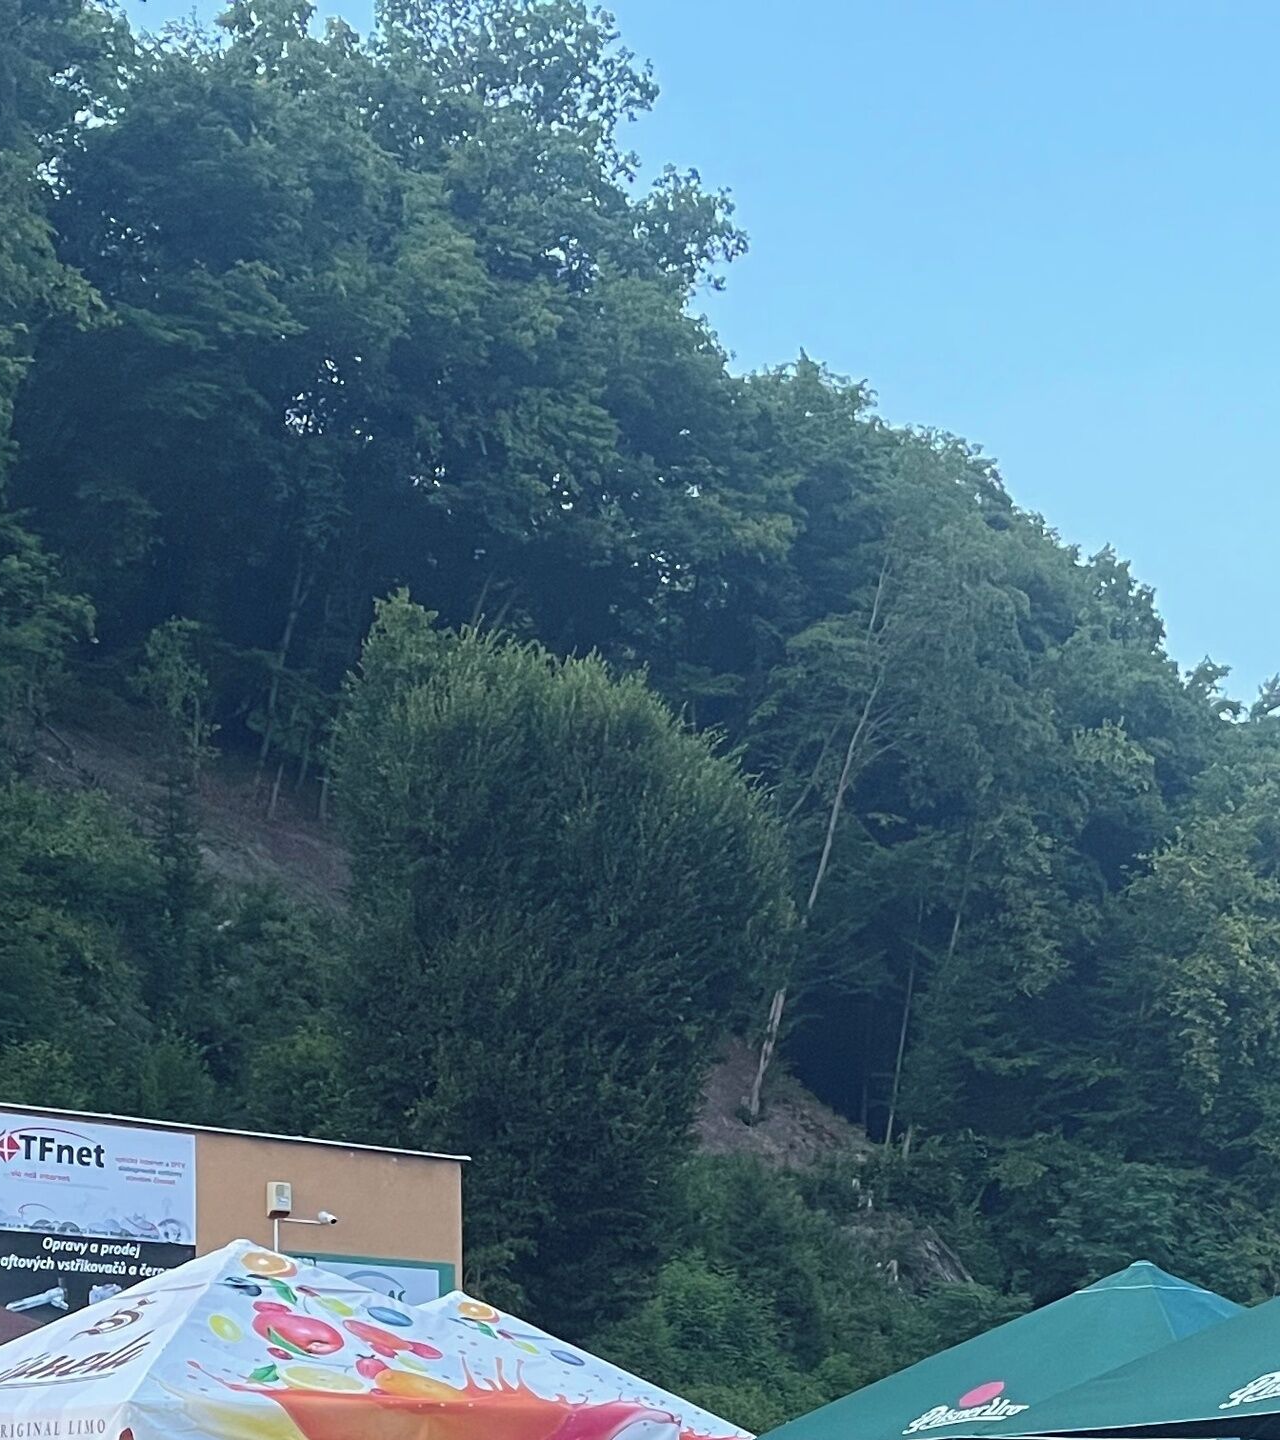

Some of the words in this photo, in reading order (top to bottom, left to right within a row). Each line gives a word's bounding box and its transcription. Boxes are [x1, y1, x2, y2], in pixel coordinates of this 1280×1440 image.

[19, 1134, 105, 1168] TFnet
[42, 1236, 88, 1255] Opravy
[90, 1242, 97, 1253] a
[100, 1243, 141, 1258] prodej
[56, 1258, 126, 1276] vstřikovačů
[128, 1266, 136, 1276] a
[68, 1418, 106, 1436] LIMO
